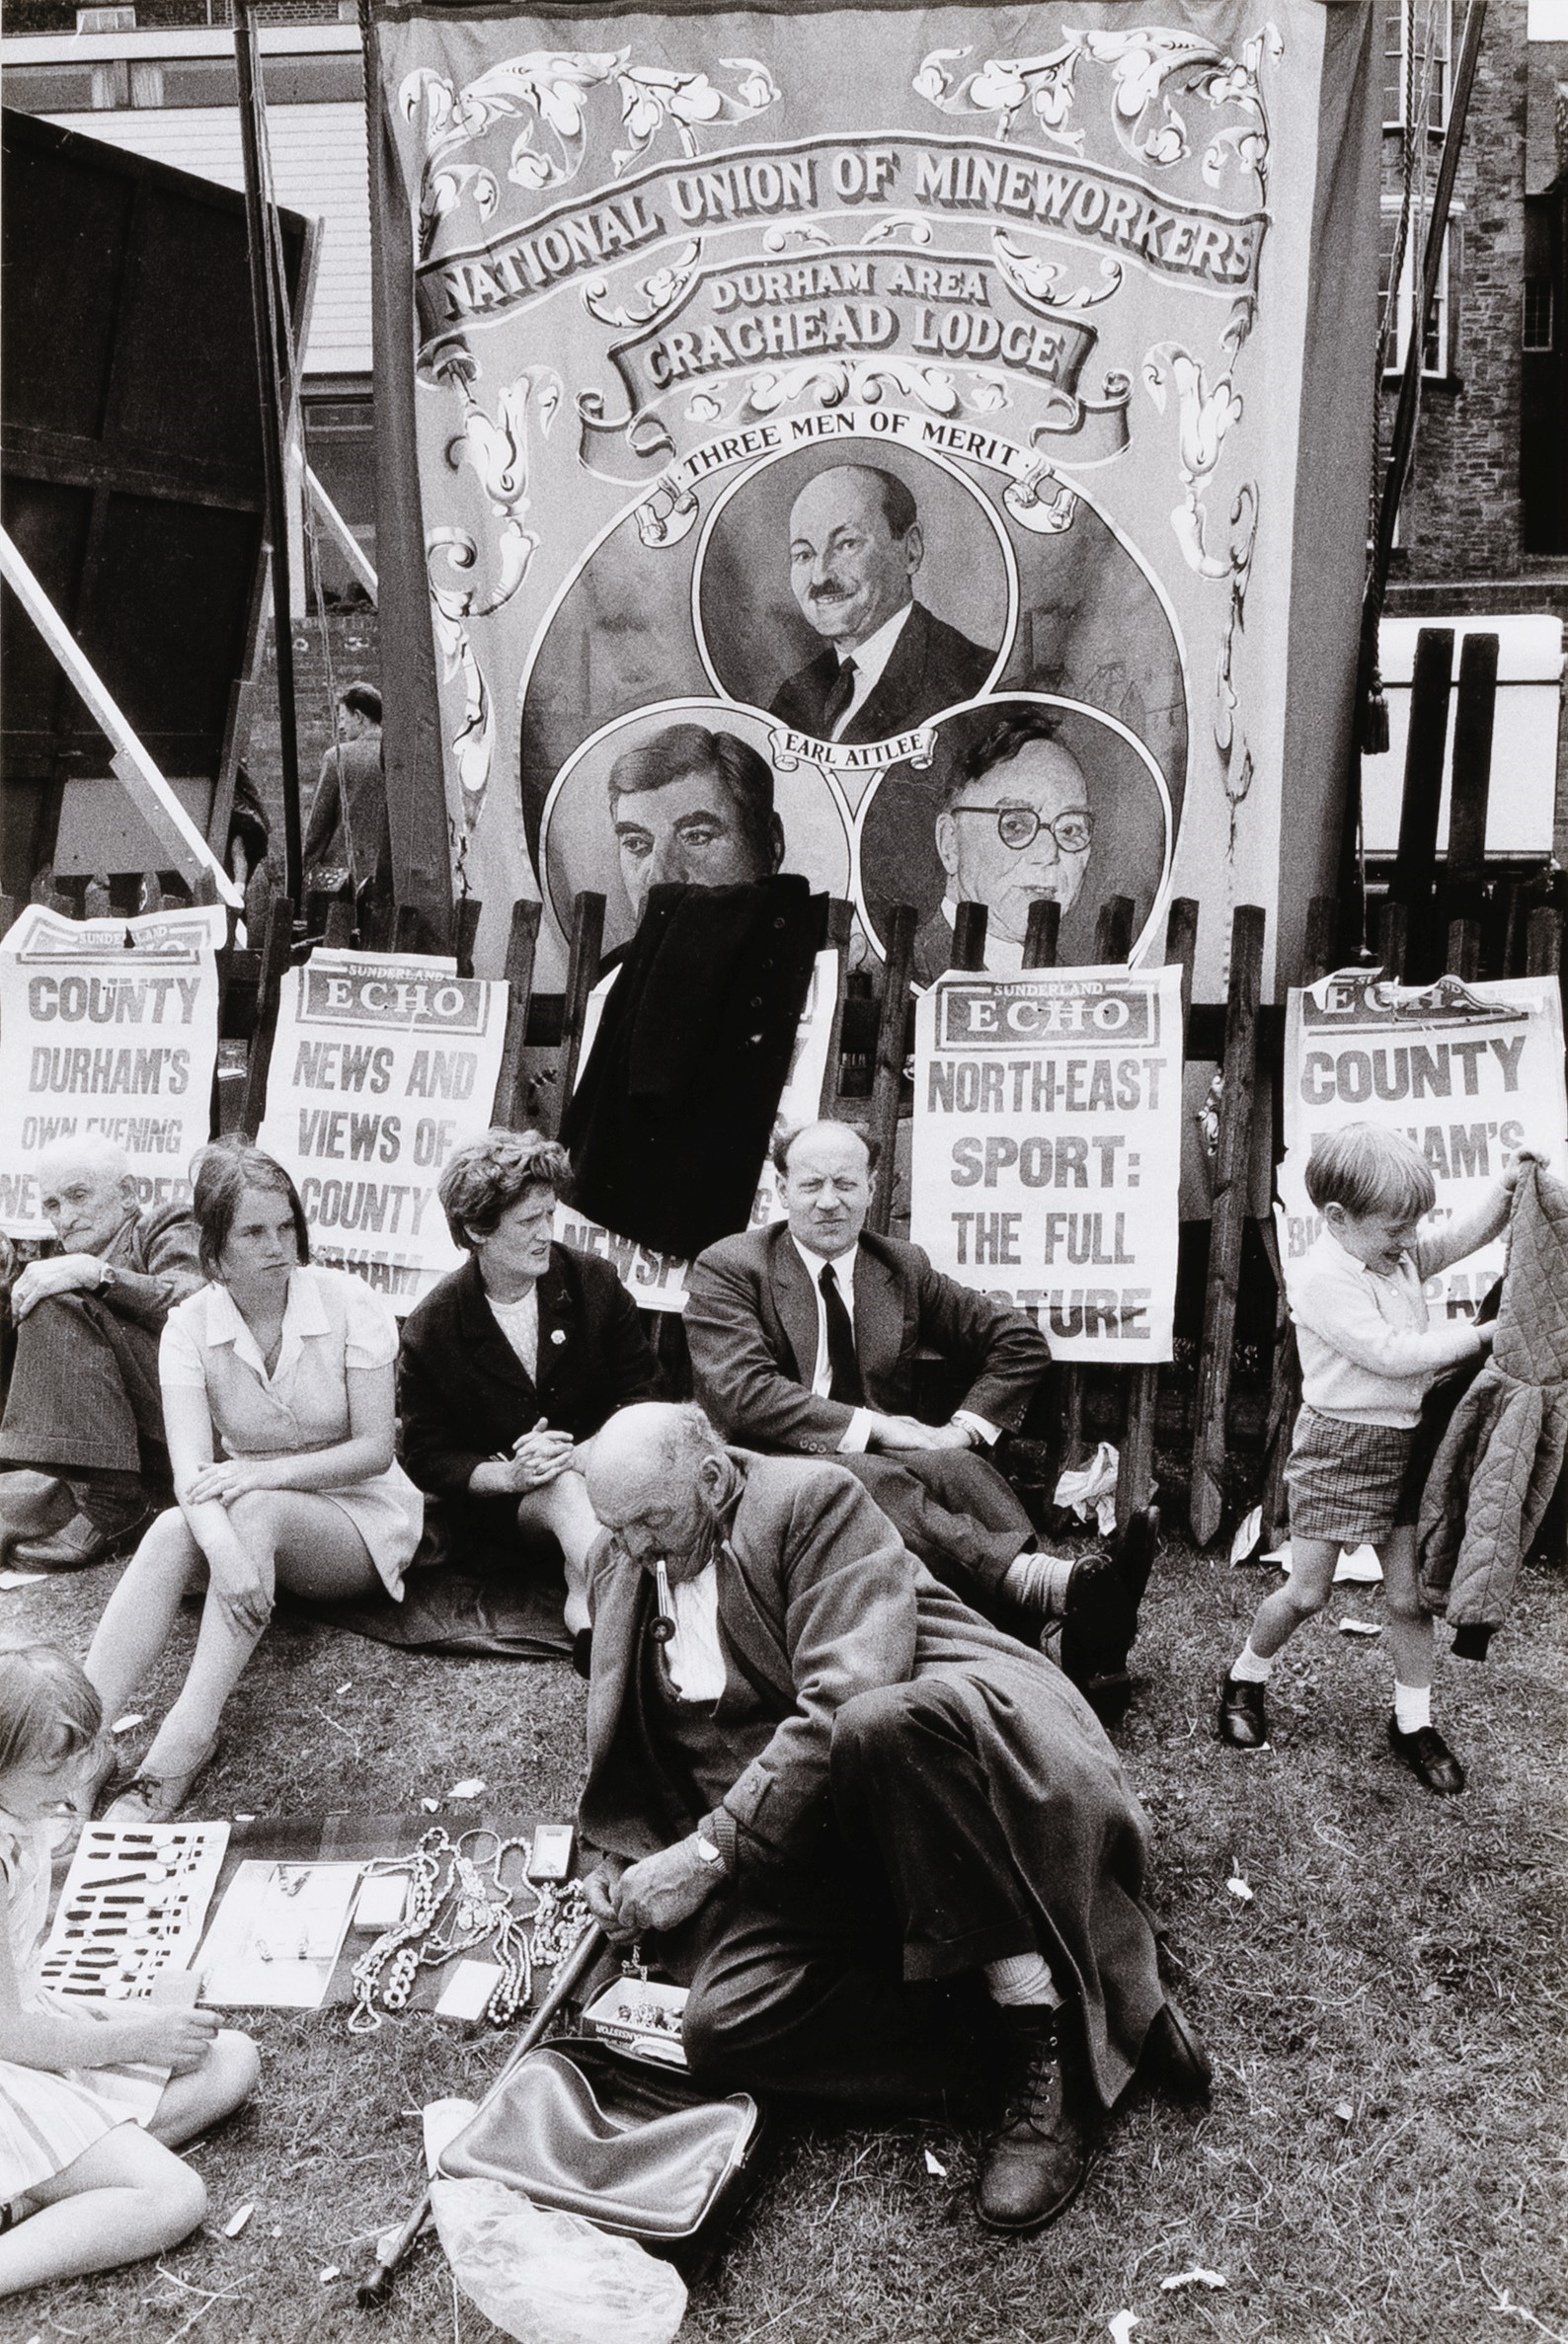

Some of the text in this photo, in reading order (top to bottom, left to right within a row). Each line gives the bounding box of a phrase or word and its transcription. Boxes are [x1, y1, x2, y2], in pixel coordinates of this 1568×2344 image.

[444, 150, 1253, 318] NATIONAL UNION OF MINEWORKERS
[711, 263, 990, 313] DURHAM AREA
[645, 303, 1065, 388] CRAGHEAD LODGE
[683, 411, 1020, 477] THREE MEN OF MERIT
[785, 734, 923, 766] EARL ATTLEE
[325, 977, 465, 1017] ECHO
[349, 964, 446, 981] SUNDERLAND
[993, 981, 1104, 997] SUNDERLAND
[29, 976, 201, 1024] COUNTY
[967, 997, 1130, 1032] ECHO
[29, 1047, 191, 1095] DURHAM'S
[292, 1040, 478, 1100] NEWS AND
[927, 1058, 1167, 1113] NORTH-EAST
[1300, 1036, 1527, 1105] COUNTY
[298, 1108, 456, 1168] VIEWS OF
[950, 1135, 1140, 1188] SPORT:
[299, 1177, 432, 1235] COUNTY
[951, 1211, 1136, 1265] THE FULL
